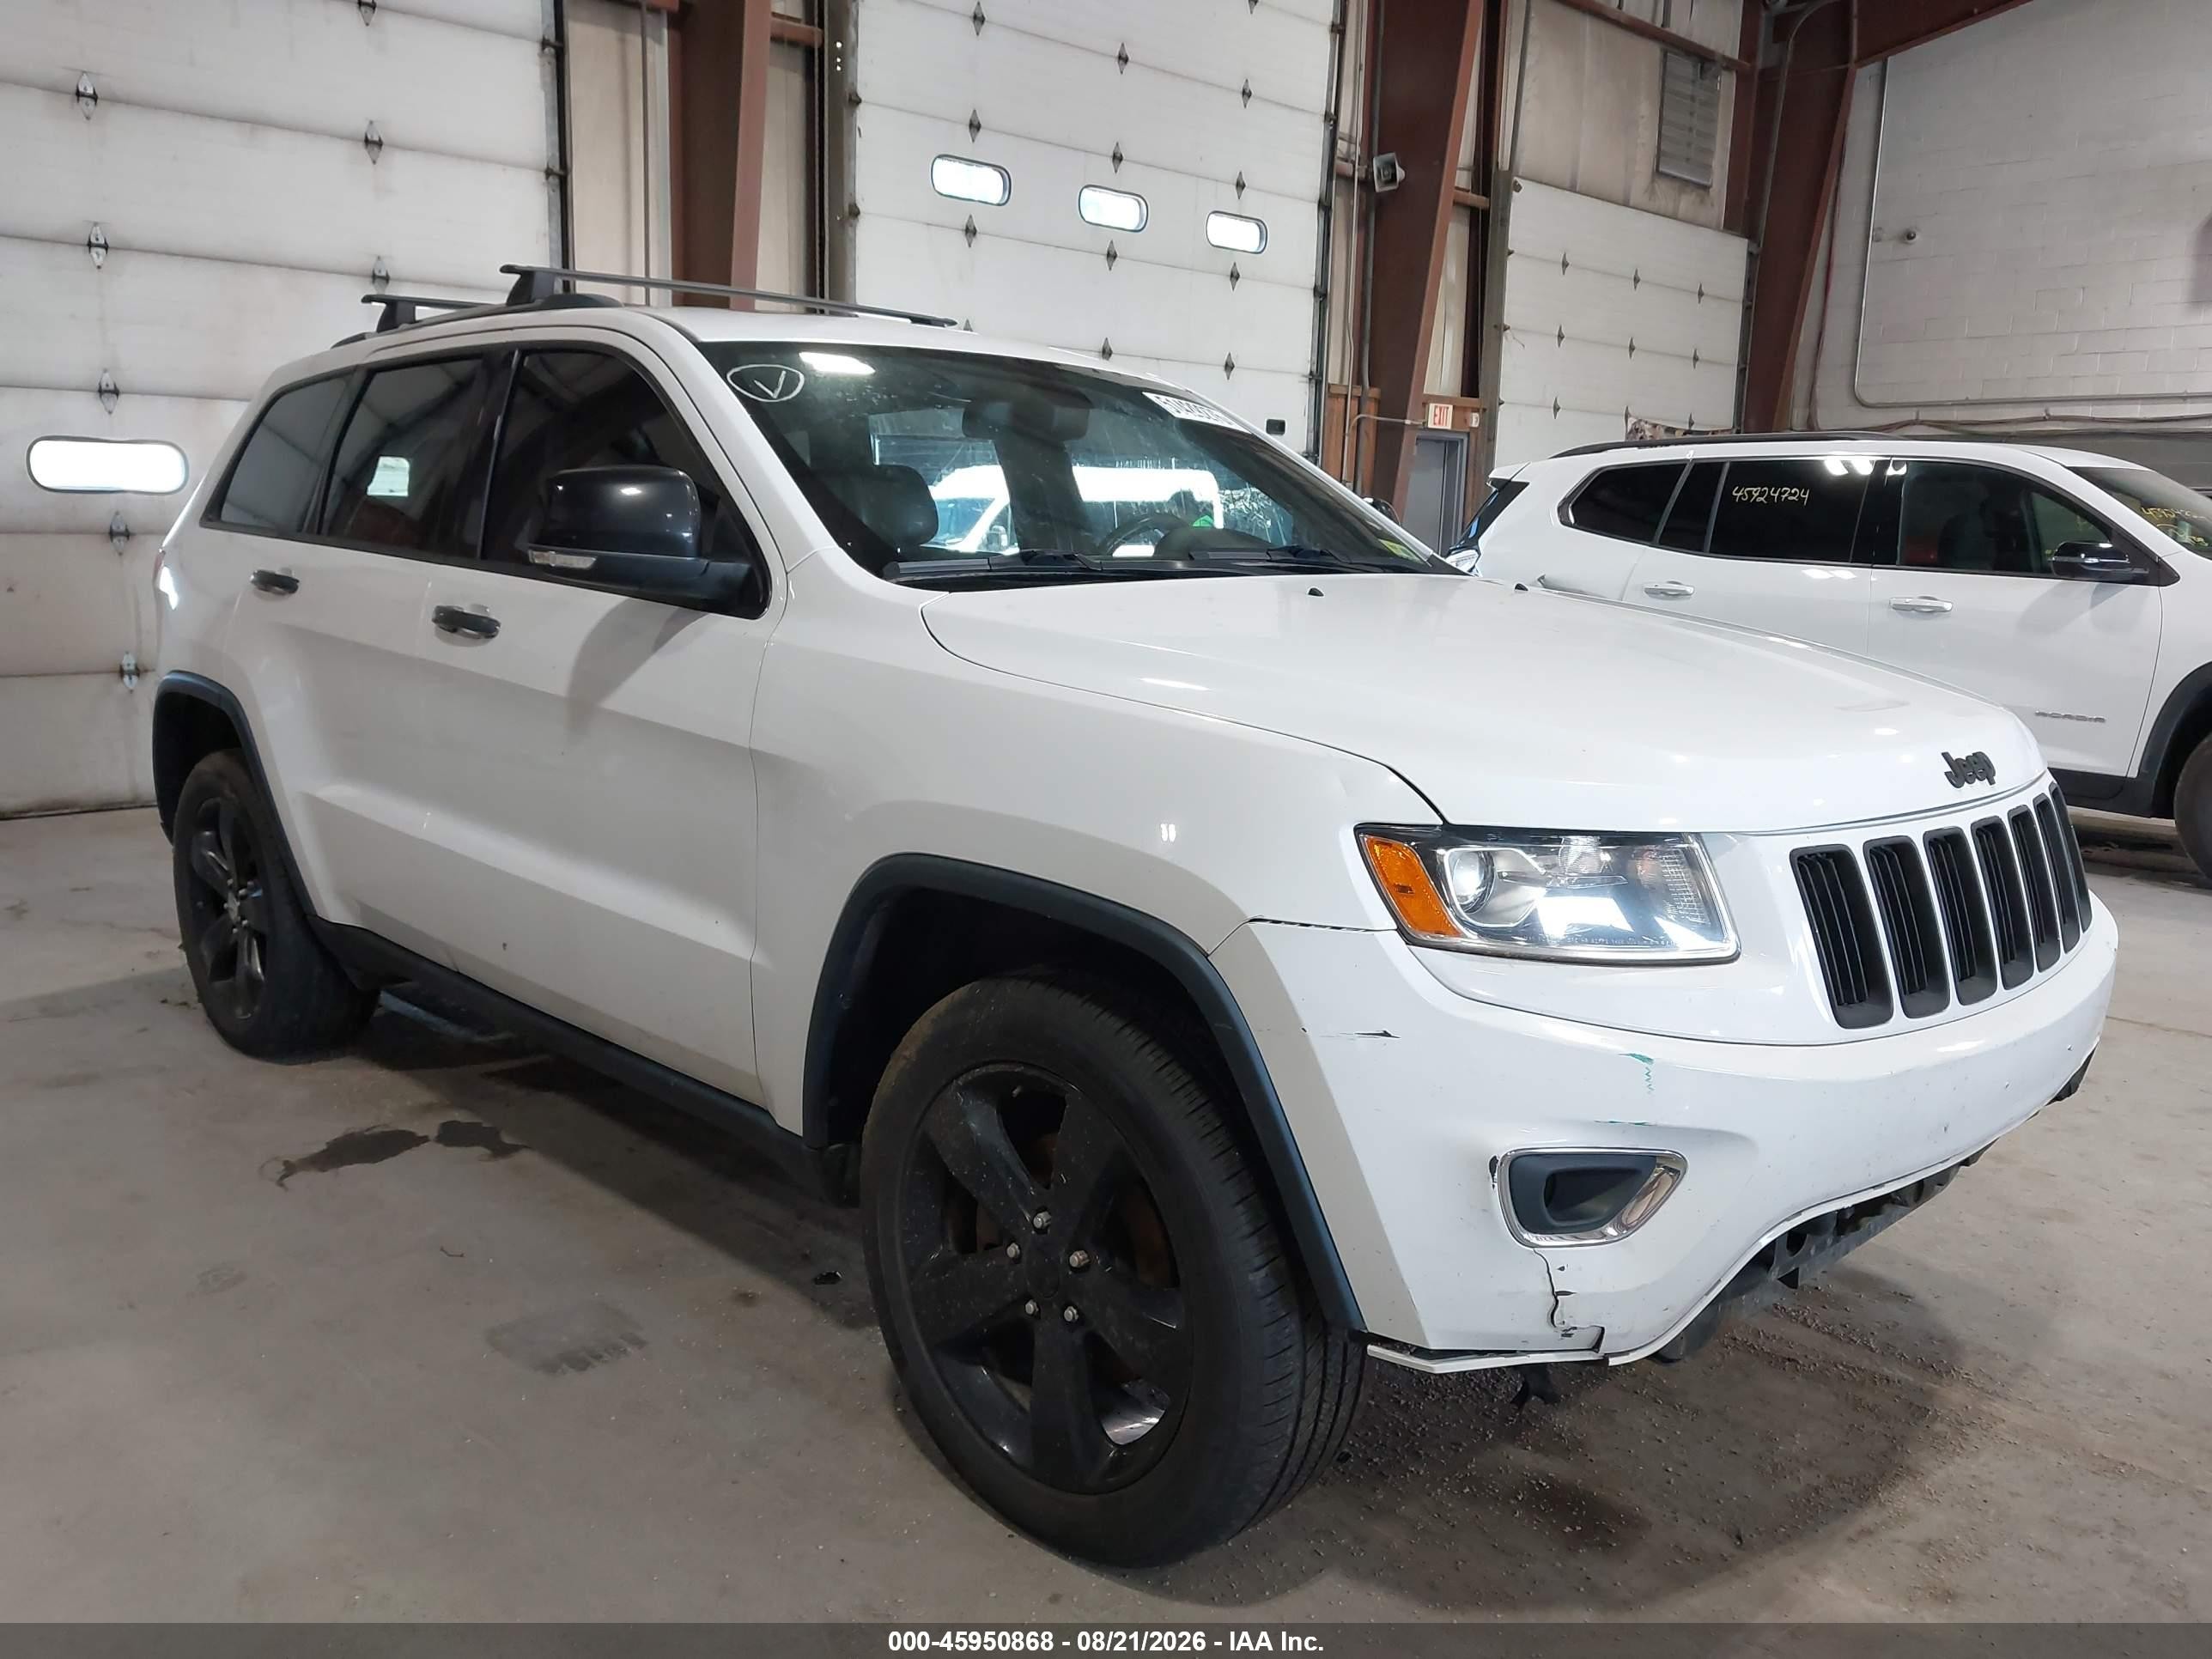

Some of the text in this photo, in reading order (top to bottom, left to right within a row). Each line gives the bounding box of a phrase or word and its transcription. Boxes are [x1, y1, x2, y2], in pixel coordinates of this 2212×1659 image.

[1432, 404, 1449, 427] EXIT
[1732, 486, 1809, 506] 45924724
[1942, 751, 1996, 788] Jeep
